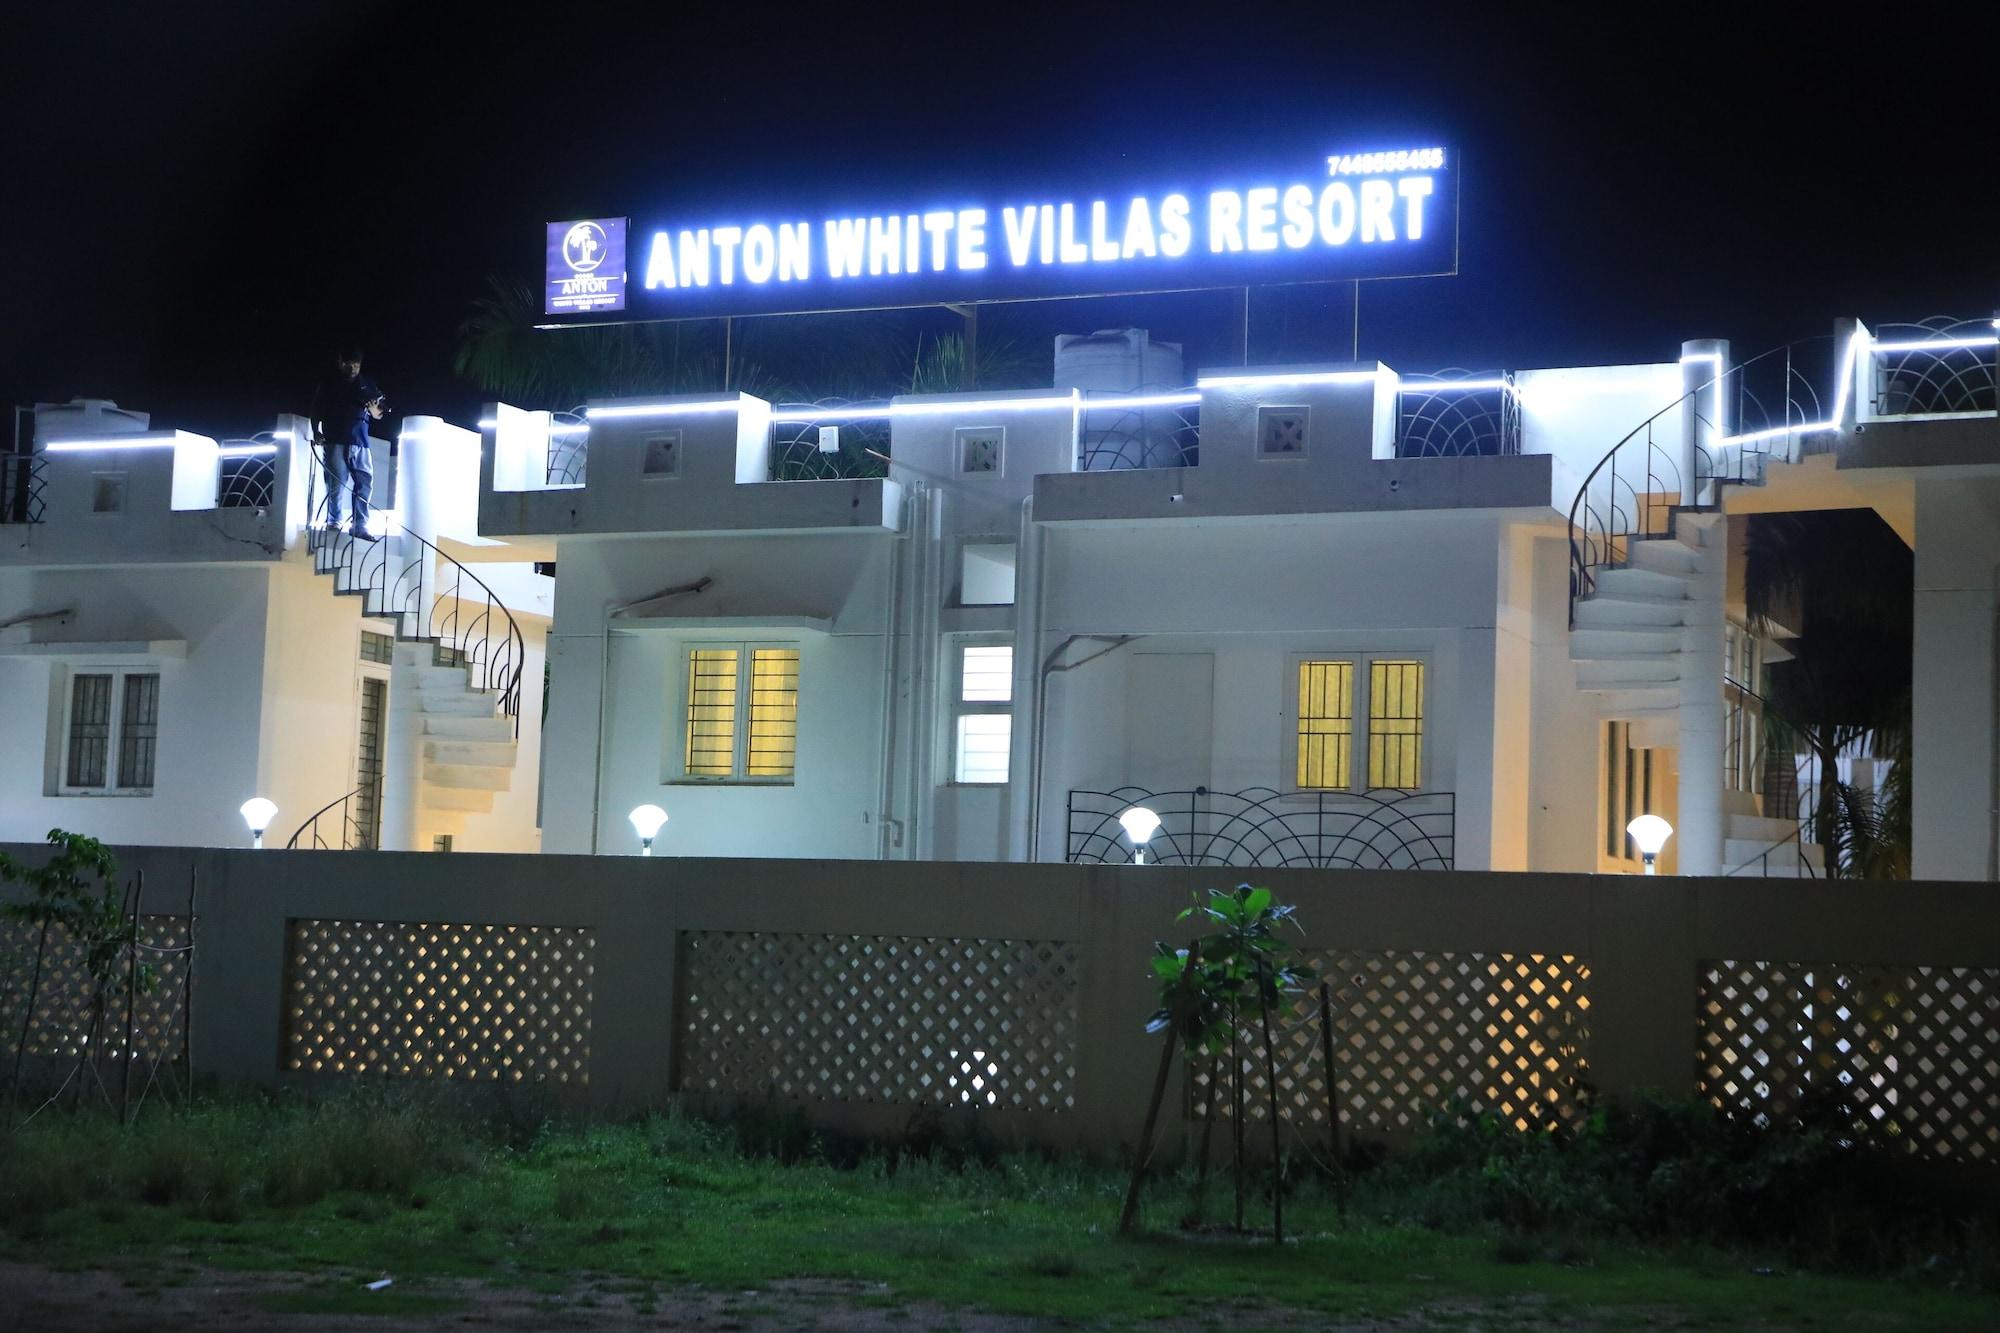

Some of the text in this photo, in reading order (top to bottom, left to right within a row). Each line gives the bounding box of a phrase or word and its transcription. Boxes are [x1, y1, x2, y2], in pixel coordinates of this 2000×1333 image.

[644, 175, 1434, 290] ANTON WHITE VILLAS RESORT
[562, 279, 607, 295] ANTON
